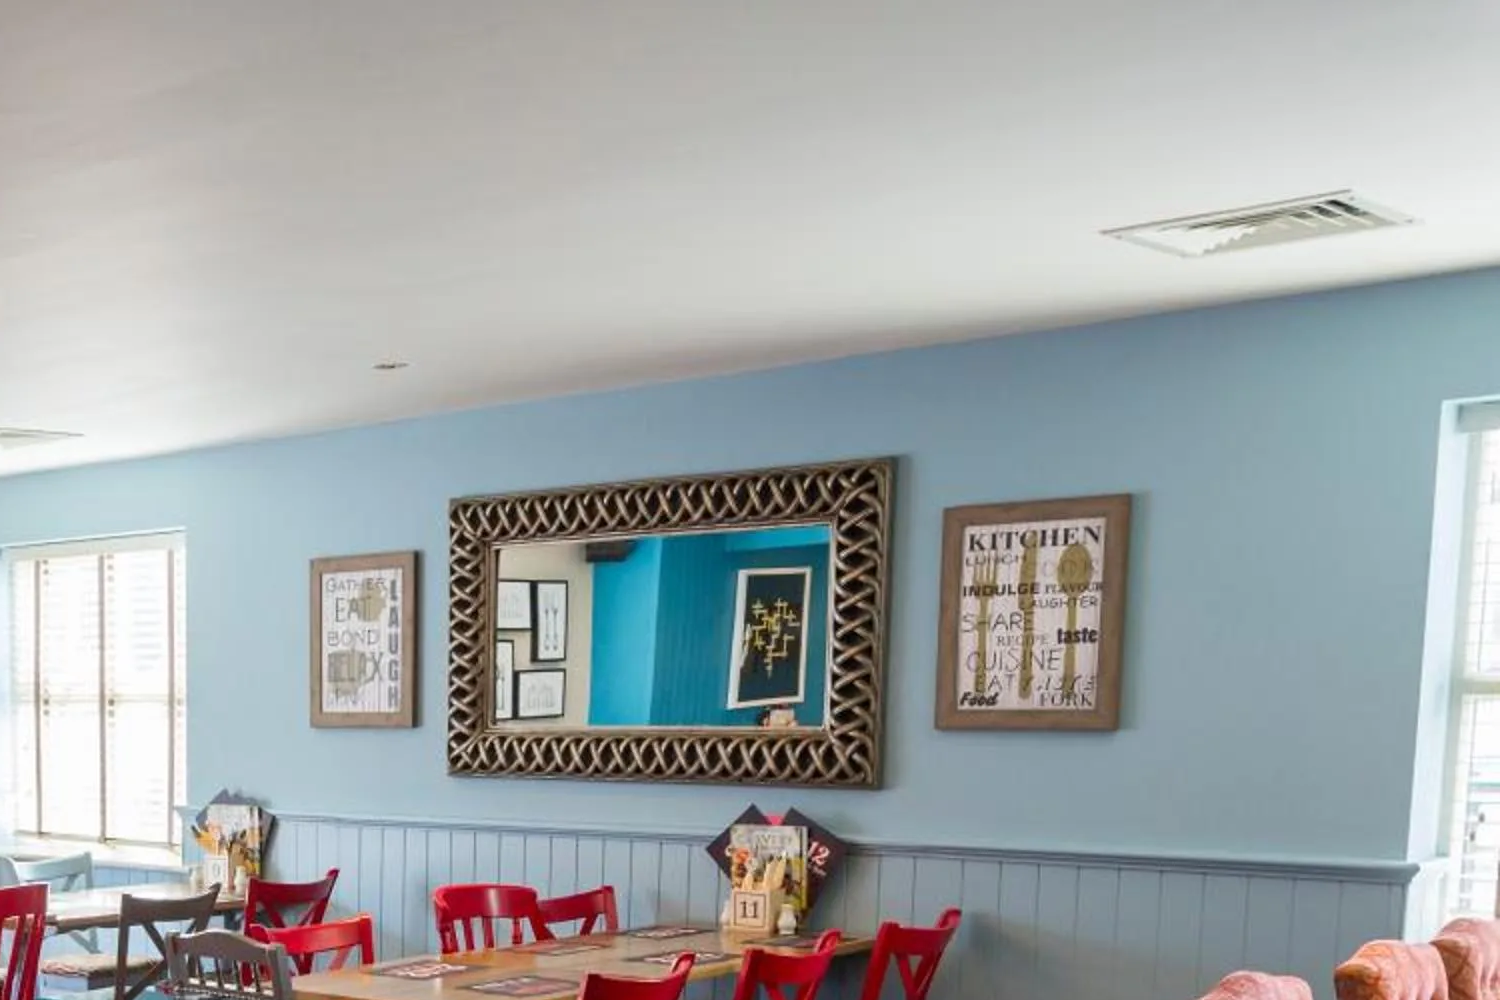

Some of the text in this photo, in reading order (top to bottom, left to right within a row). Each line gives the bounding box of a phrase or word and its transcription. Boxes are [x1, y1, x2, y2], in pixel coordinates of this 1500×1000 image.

[968, 525, 1101, 551] KITCHEN
[962, 583, 1040, 597] INDULGE
[334, 597, 371, 622] EAT
[327, 628, 380, 646] BOND
[1057, 626, 1098, 644] taste
[966, 648, 1063, 674] CUISINE
[959, 691, 999, 707] Food
[1037, 691, 1094, 707] FORK
[740, 900, 759, 919] 11
